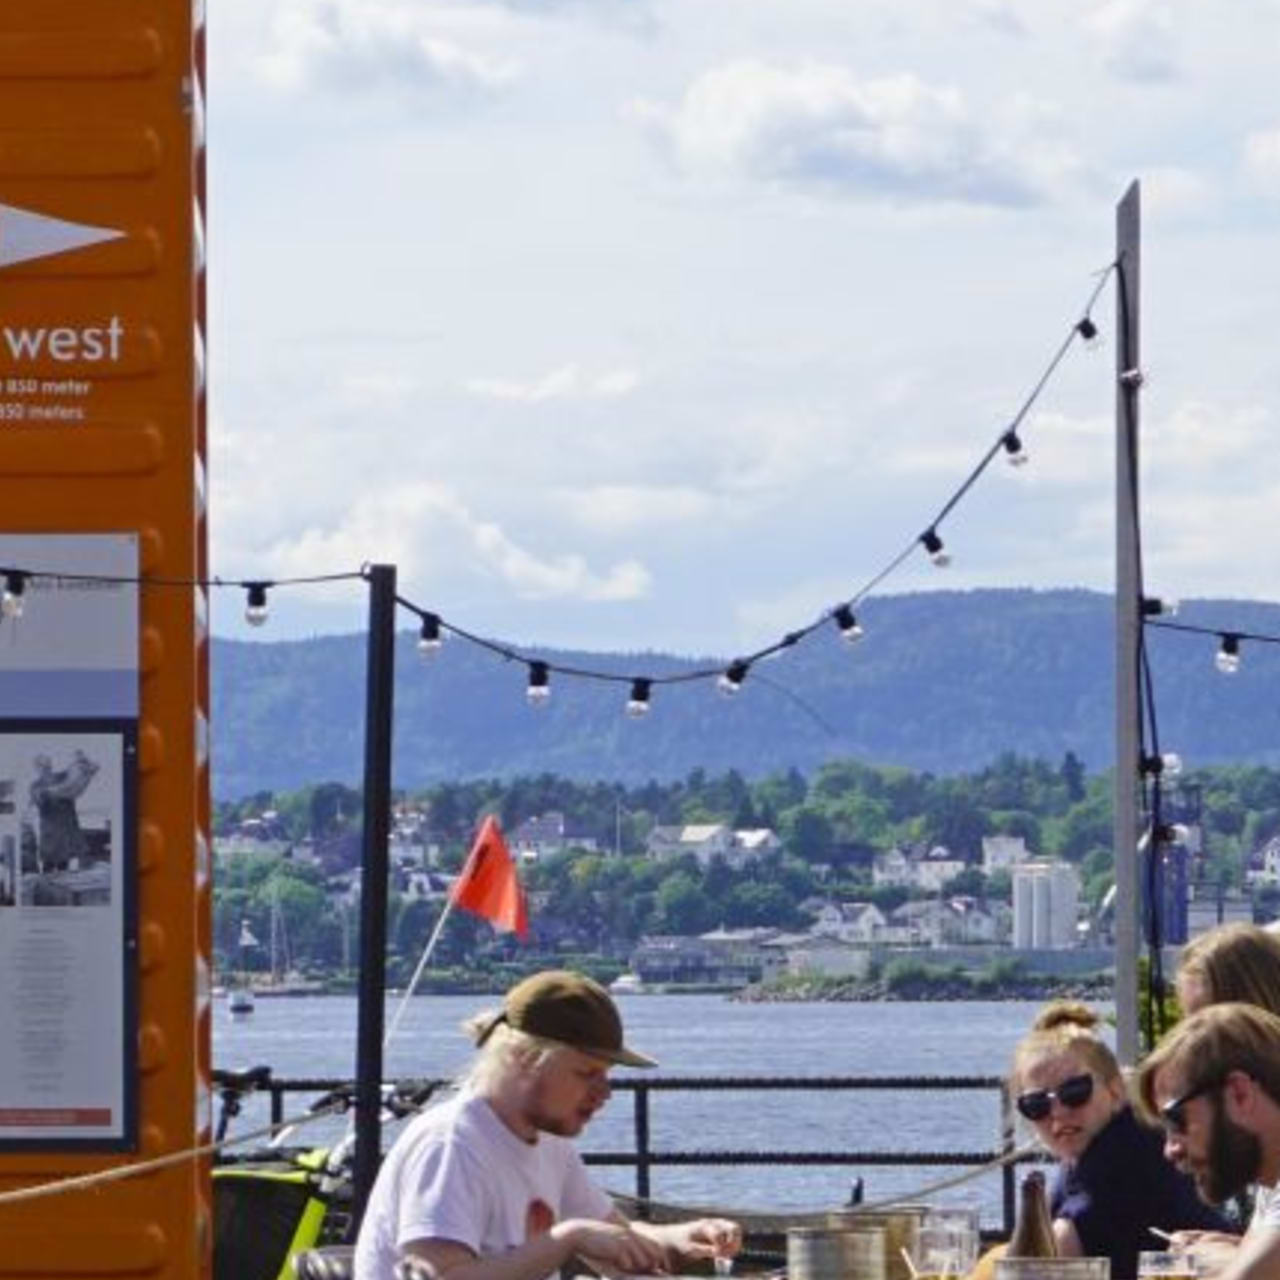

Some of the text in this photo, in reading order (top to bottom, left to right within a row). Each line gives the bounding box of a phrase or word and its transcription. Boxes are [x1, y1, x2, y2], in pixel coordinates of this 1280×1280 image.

[3, 315, 125, 361] west
[6, 378, 38, 394] 850
[42, 379, 90, 396] meter
[28, 404, 85, 422] meters
